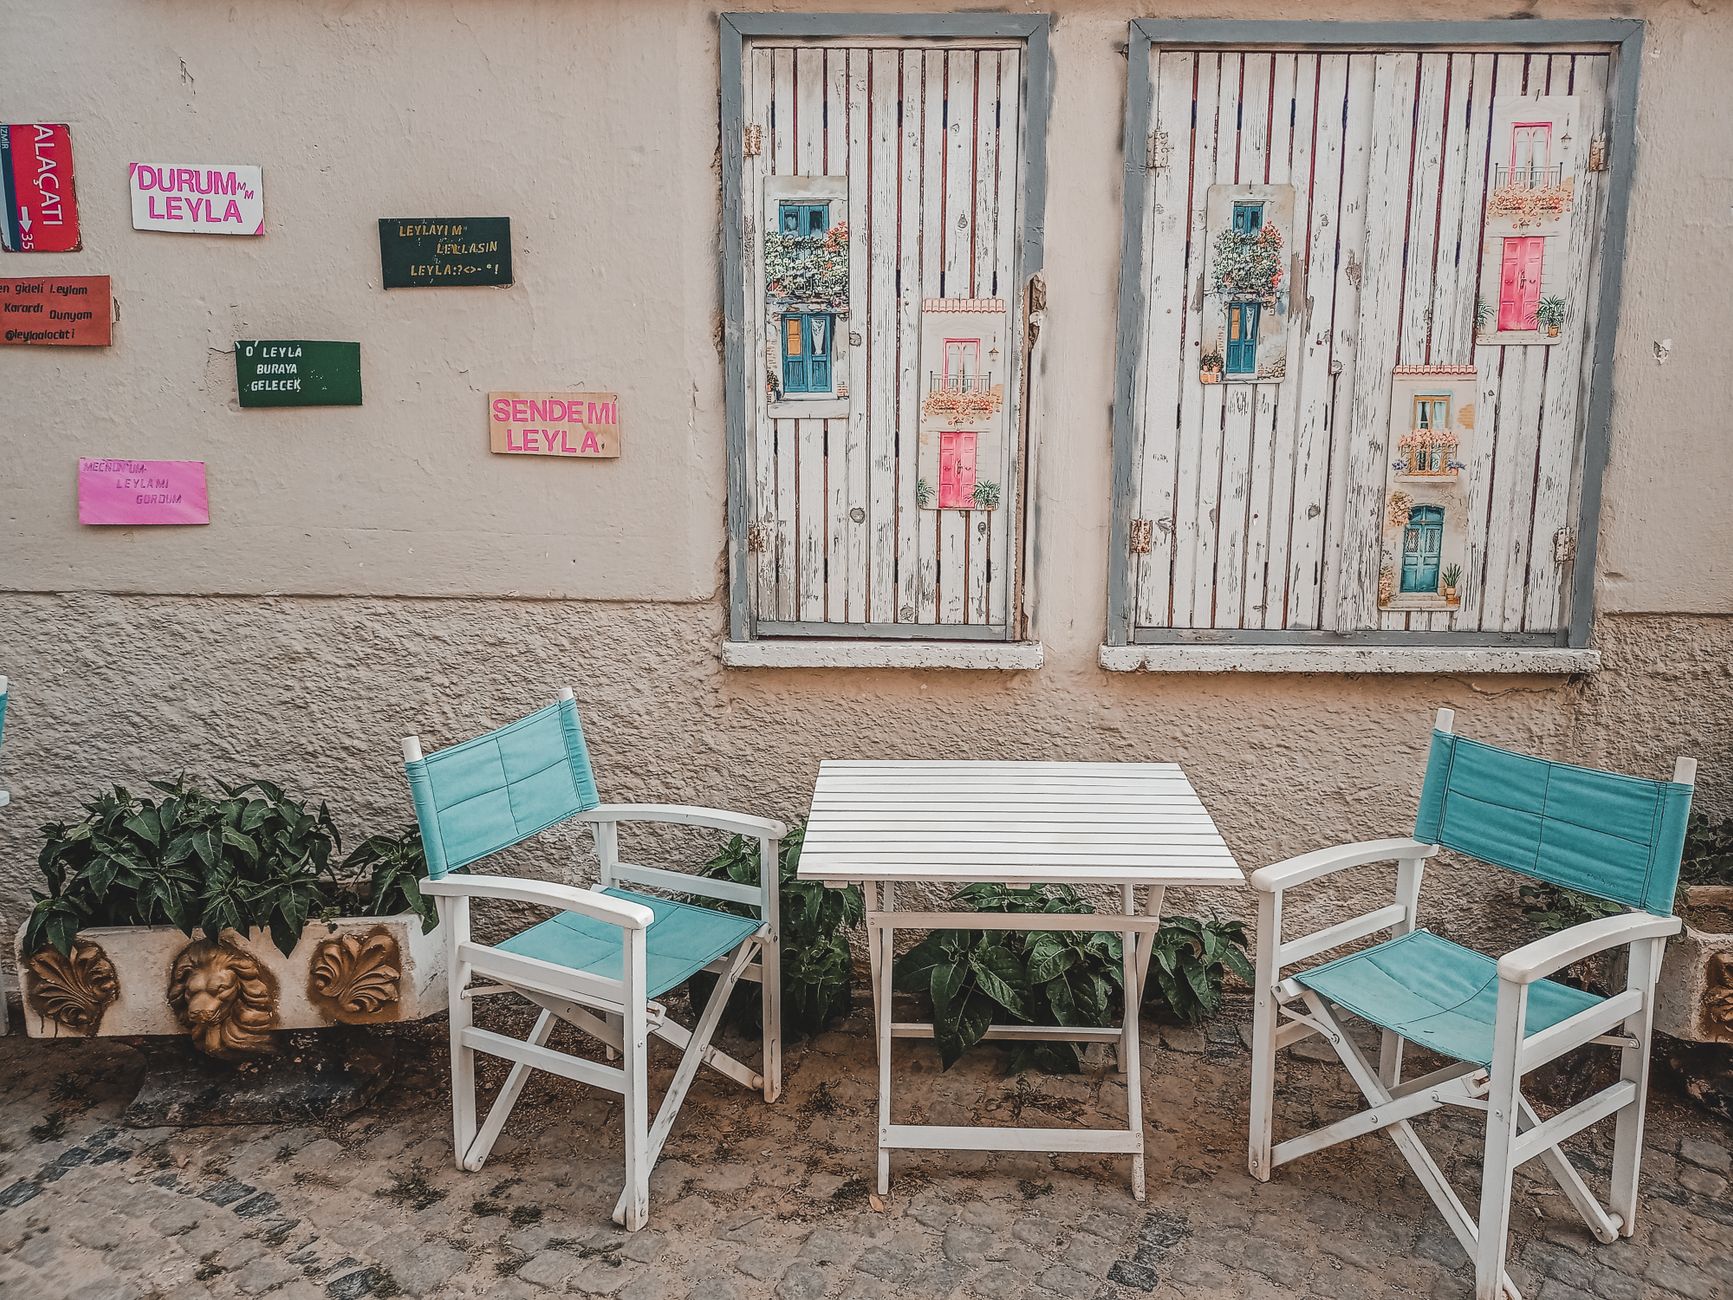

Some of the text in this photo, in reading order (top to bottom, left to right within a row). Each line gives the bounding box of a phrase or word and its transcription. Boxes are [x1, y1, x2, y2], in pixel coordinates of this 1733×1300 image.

[33, 124, 63, 225] ALAÇATI
[148, 196, 243, 223] LEYLA
[21, 233, 34, 250] 35
[262, 346, 302, 357] LEYLA
[256, 364, 297, 374] BURAYA
[251, 379, 301, 392] GELECEK
